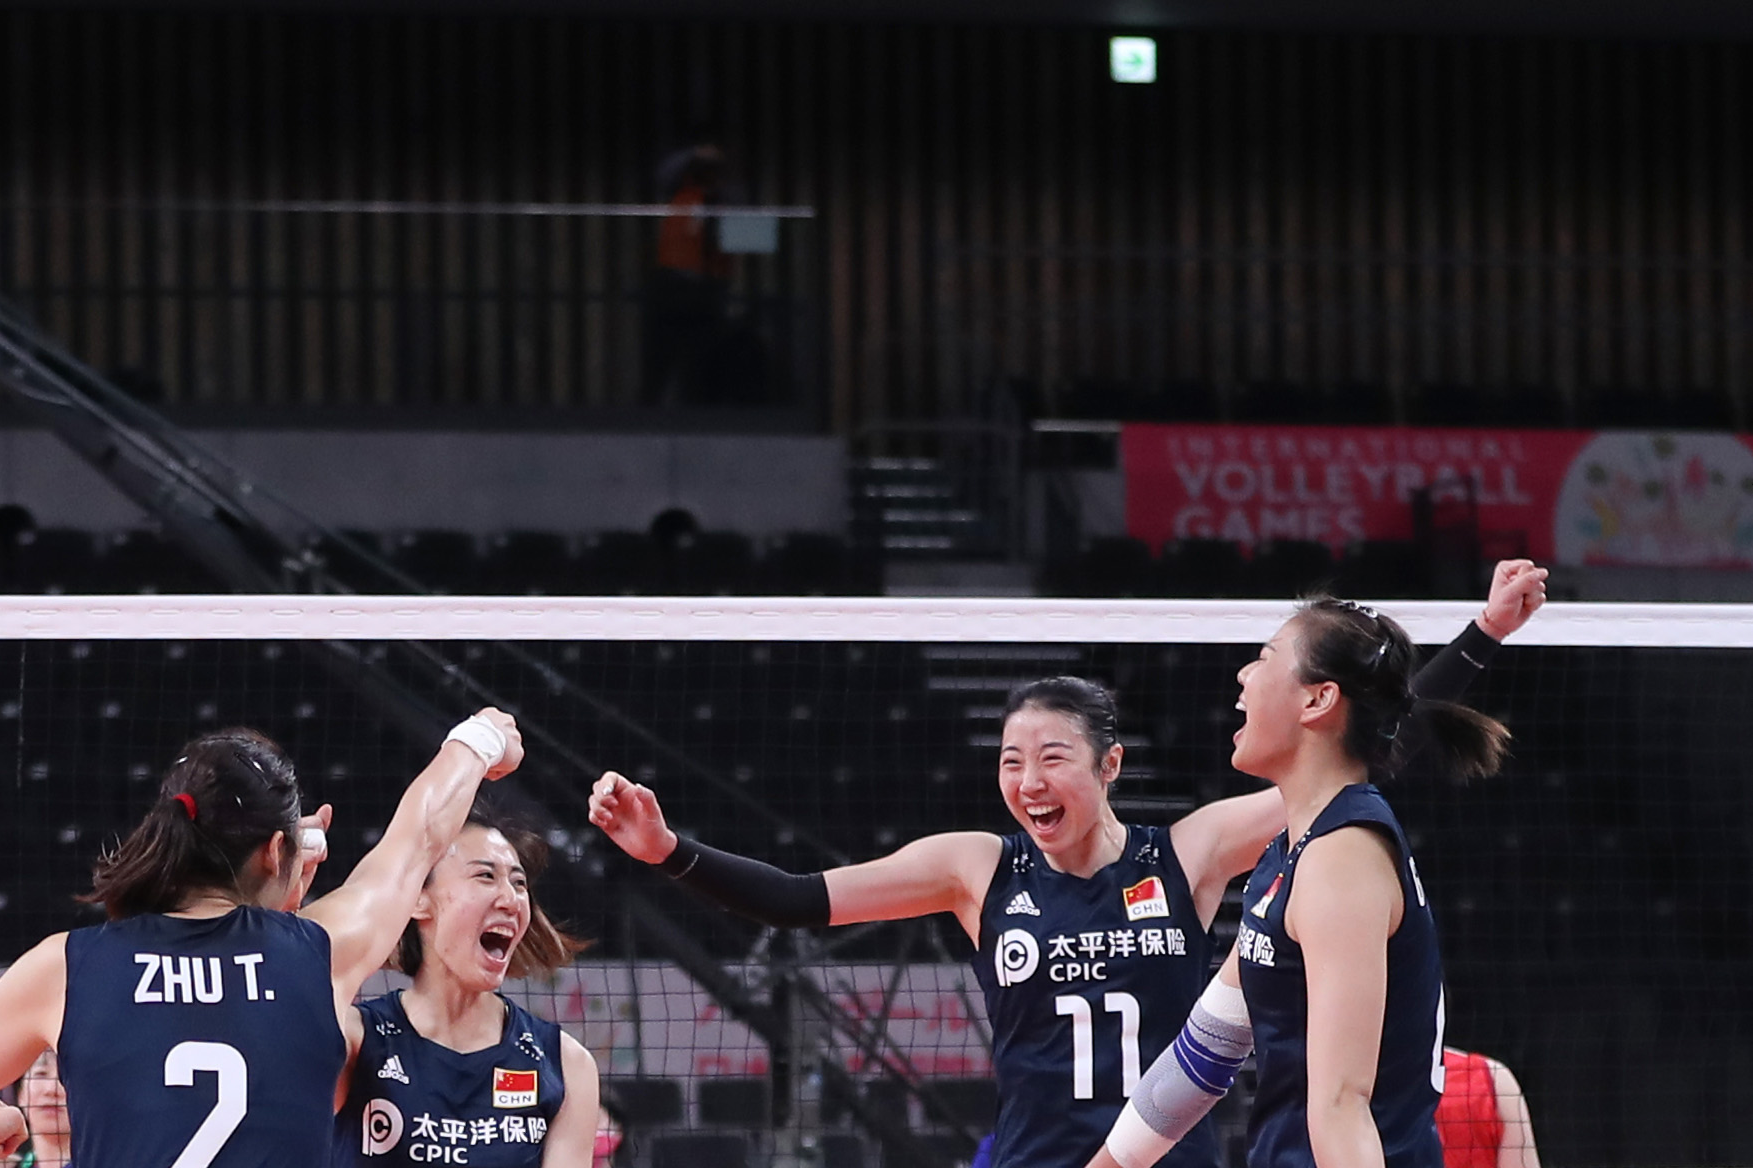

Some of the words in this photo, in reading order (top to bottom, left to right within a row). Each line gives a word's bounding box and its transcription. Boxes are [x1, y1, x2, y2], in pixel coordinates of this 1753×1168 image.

[1131, 901, 1165, 916] CHN
[1048, 928, 1187, 960] 太平洋保险
[134, 953, 224, 1003] ZHU
[233, 953, 276, 1001] T.
[1049, 962, 1108, 982] CPIC
[1055, 992, 1141, 1099] 11
[498, 1094, 533, 1105] CHN
[408, 1142, 468, 1164] CPIC
